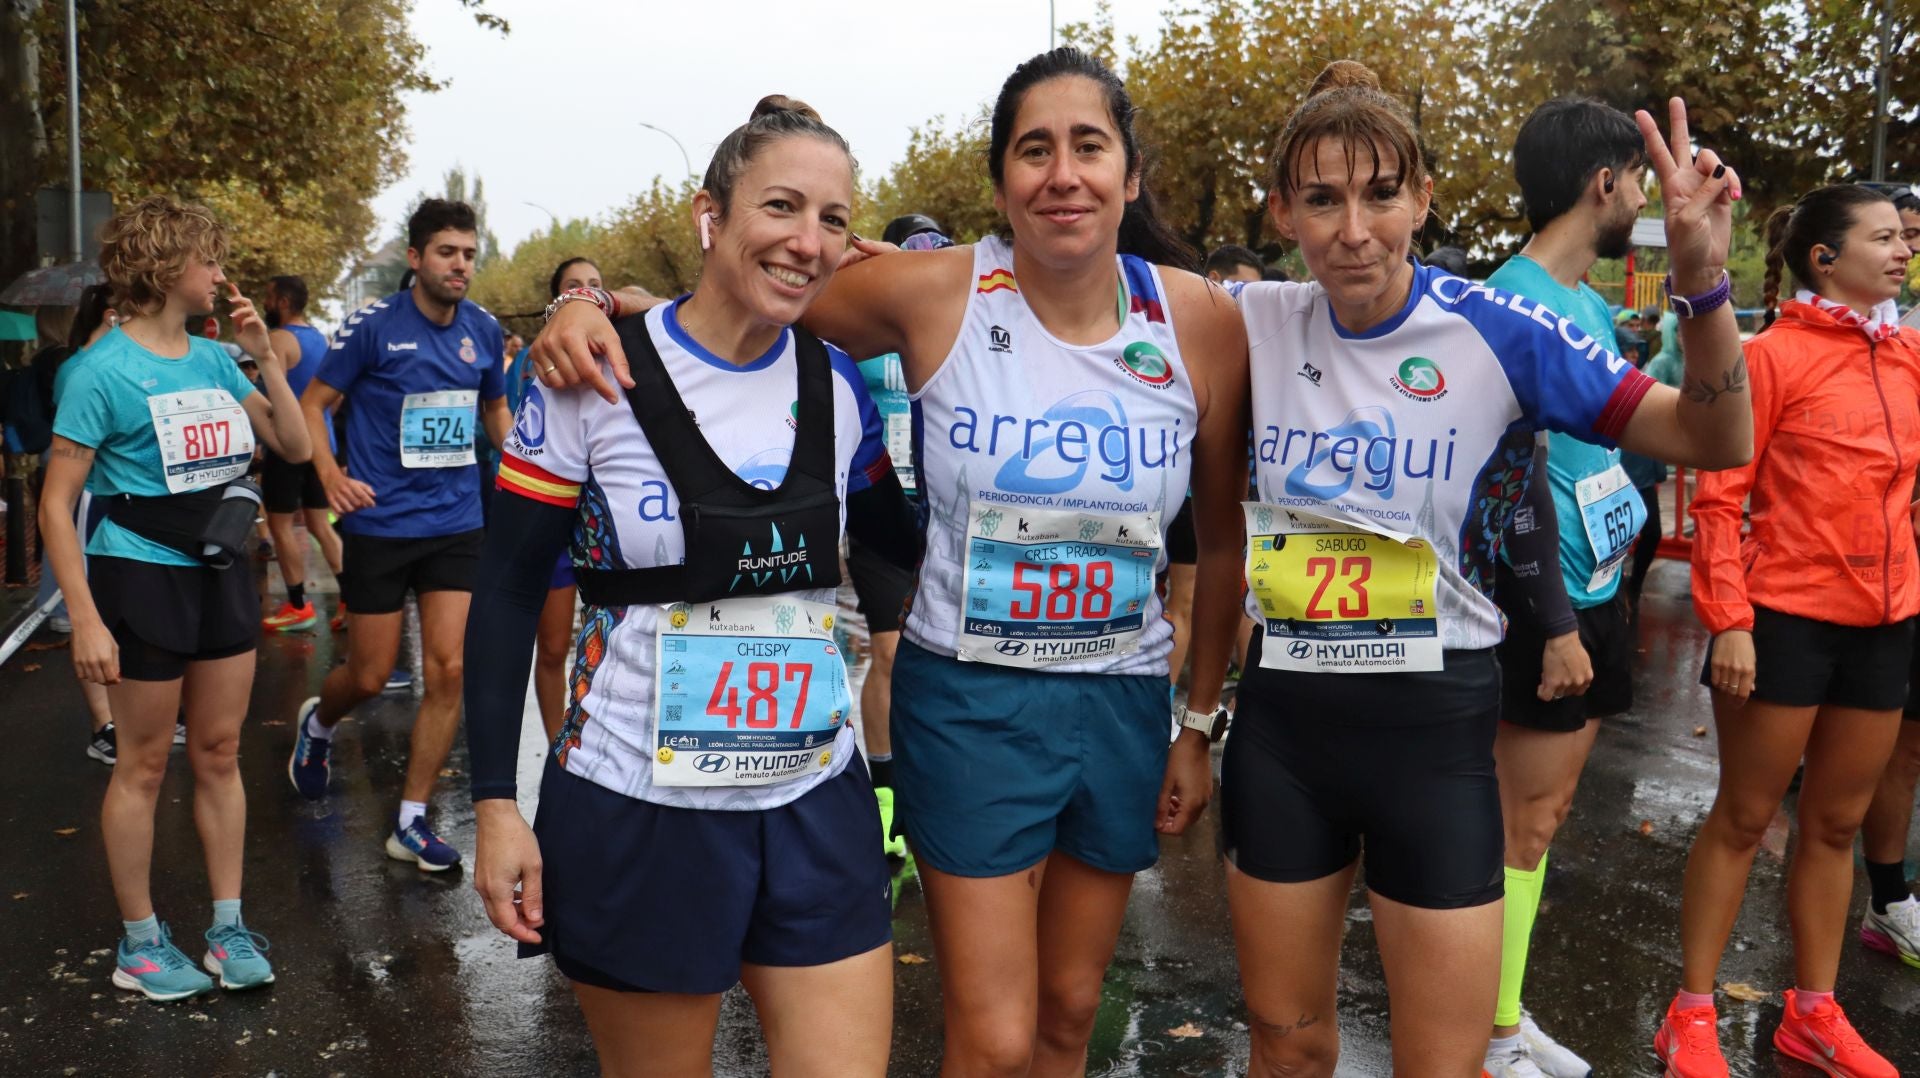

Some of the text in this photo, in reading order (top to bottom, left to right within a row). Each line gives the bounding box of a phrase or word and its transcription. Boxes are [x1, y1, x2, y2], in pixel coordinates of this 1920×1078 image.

[1399, 388, 1432, 402] ATLETISMO
[1433, 389, 1449, 401] LEON
[422, 417, 465, 445] 524
[183, 420, 230, 461] 807
[949, 406, 1181, 483] arregui
[1259, 425, 1457, 491] arregui
[199, 466, 240, 478] HYUNDAI
[979, 490, 1053, 507] PERIODONCIA
[1063, 498, 1148, 513] IMPLANTOLOGÍA
[1278, 496, 1327, 510] PERIODON
[1290, 521, 1330, 529] kutxabank
[1604, 500, 1635, 553] 662
[1017, 532, 1060, 541] kutxabank
[1315, 538, 1366, 552] SABUGO
[738, 550, 807, 571] RUNITUDE
[1024, 546, 1107, 561] CRIS PRADO
[1009, 560, 1114, 621] 588
[1305, 556, 1372, 619] 23
[709, 623, 755, 632] kutxabank
[737, 642, 791, 657] CHISPY
[1034, 637, 1116, 656] HYUNDAI
[1316, 642, 1405, 659] HYUNDAI
[1033, 650, 1113, 663] Lemauto Automoción
[1353, 657, 1406, 666] Automoción
[706, 661, 813, 729] 487
[735, 752, 814, 771] HYUNDAI
[735, 771, 770, 779] Lemauto
